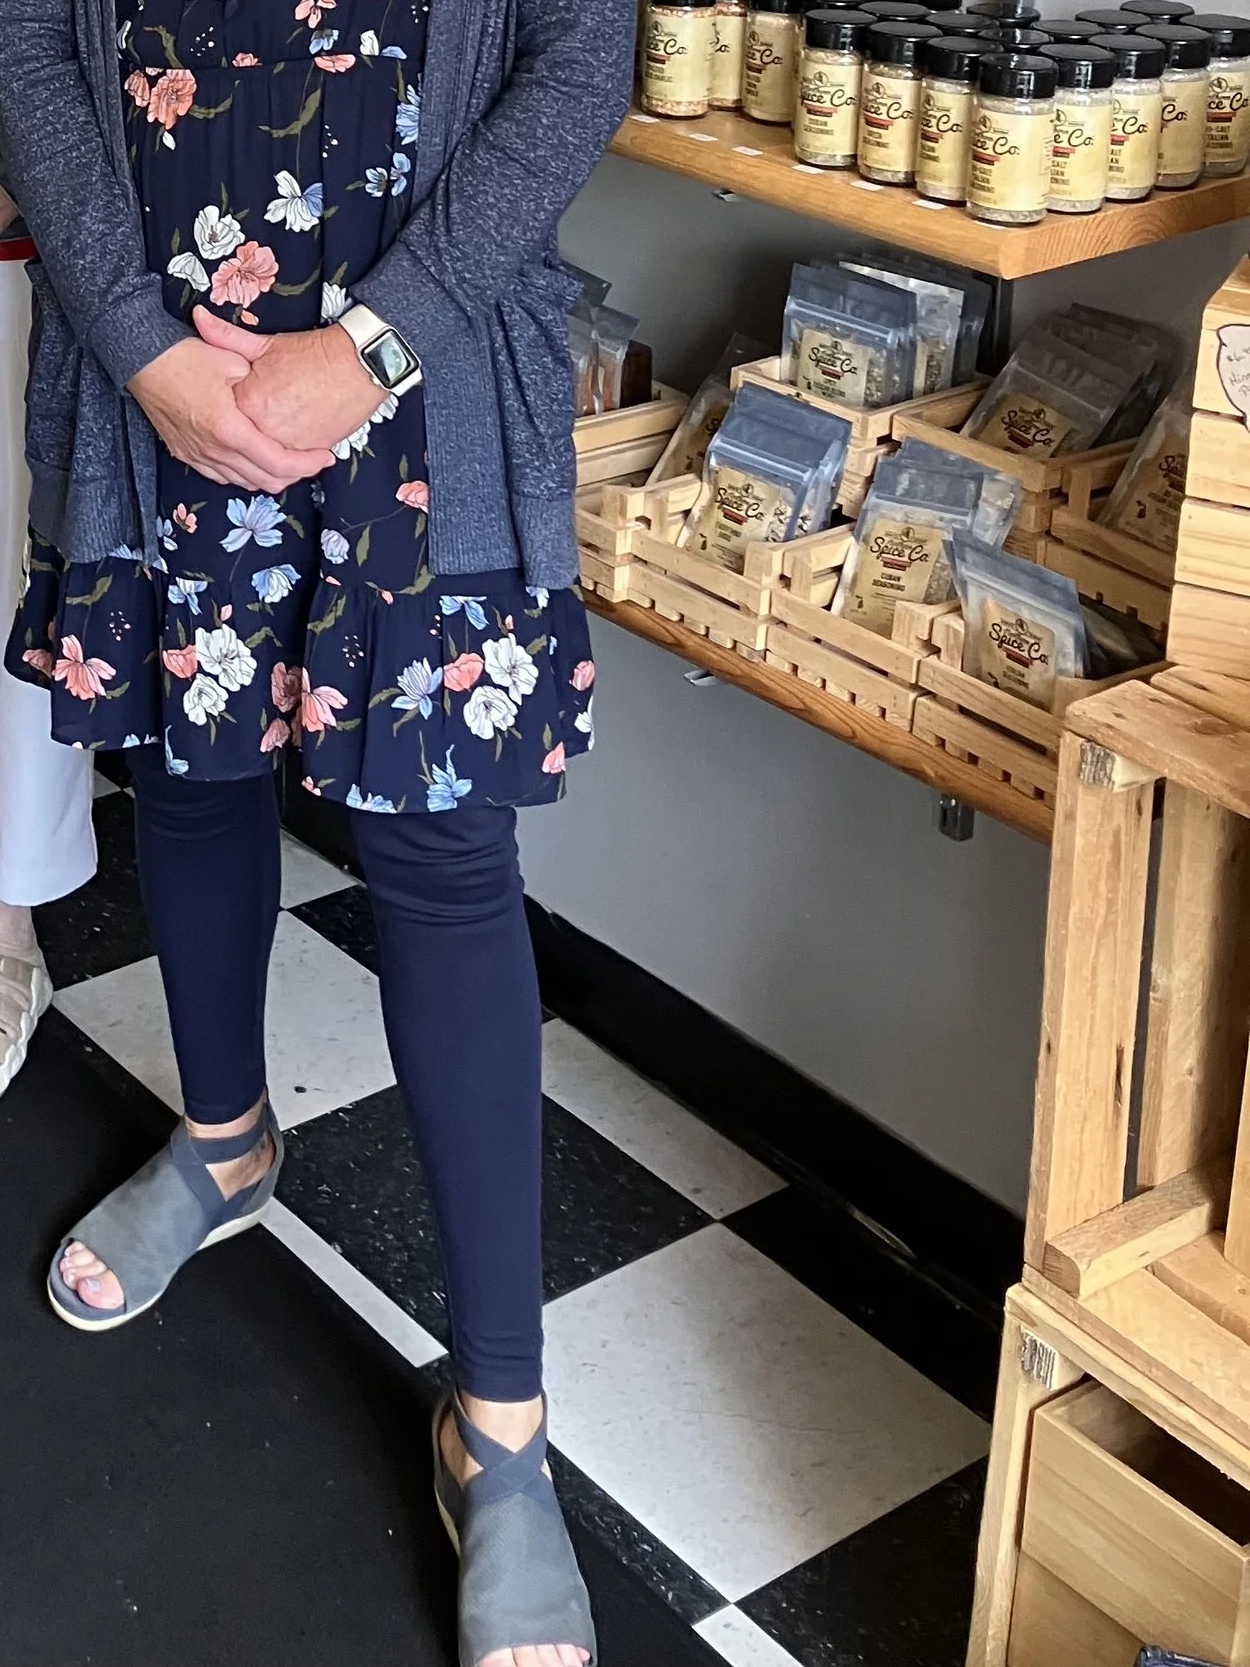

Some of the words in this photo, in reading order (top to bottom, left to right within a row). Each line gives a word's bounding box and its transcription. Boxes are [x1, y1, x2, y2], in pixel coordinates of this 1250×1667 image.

[808, 346, 837, 368] Spice
[1001, 409, 1031, 435] Spice
[714, 487, 743, 510] Spice
[870, 536, 905, 560] Spice
[989, 623, 1026, 653] Spice
